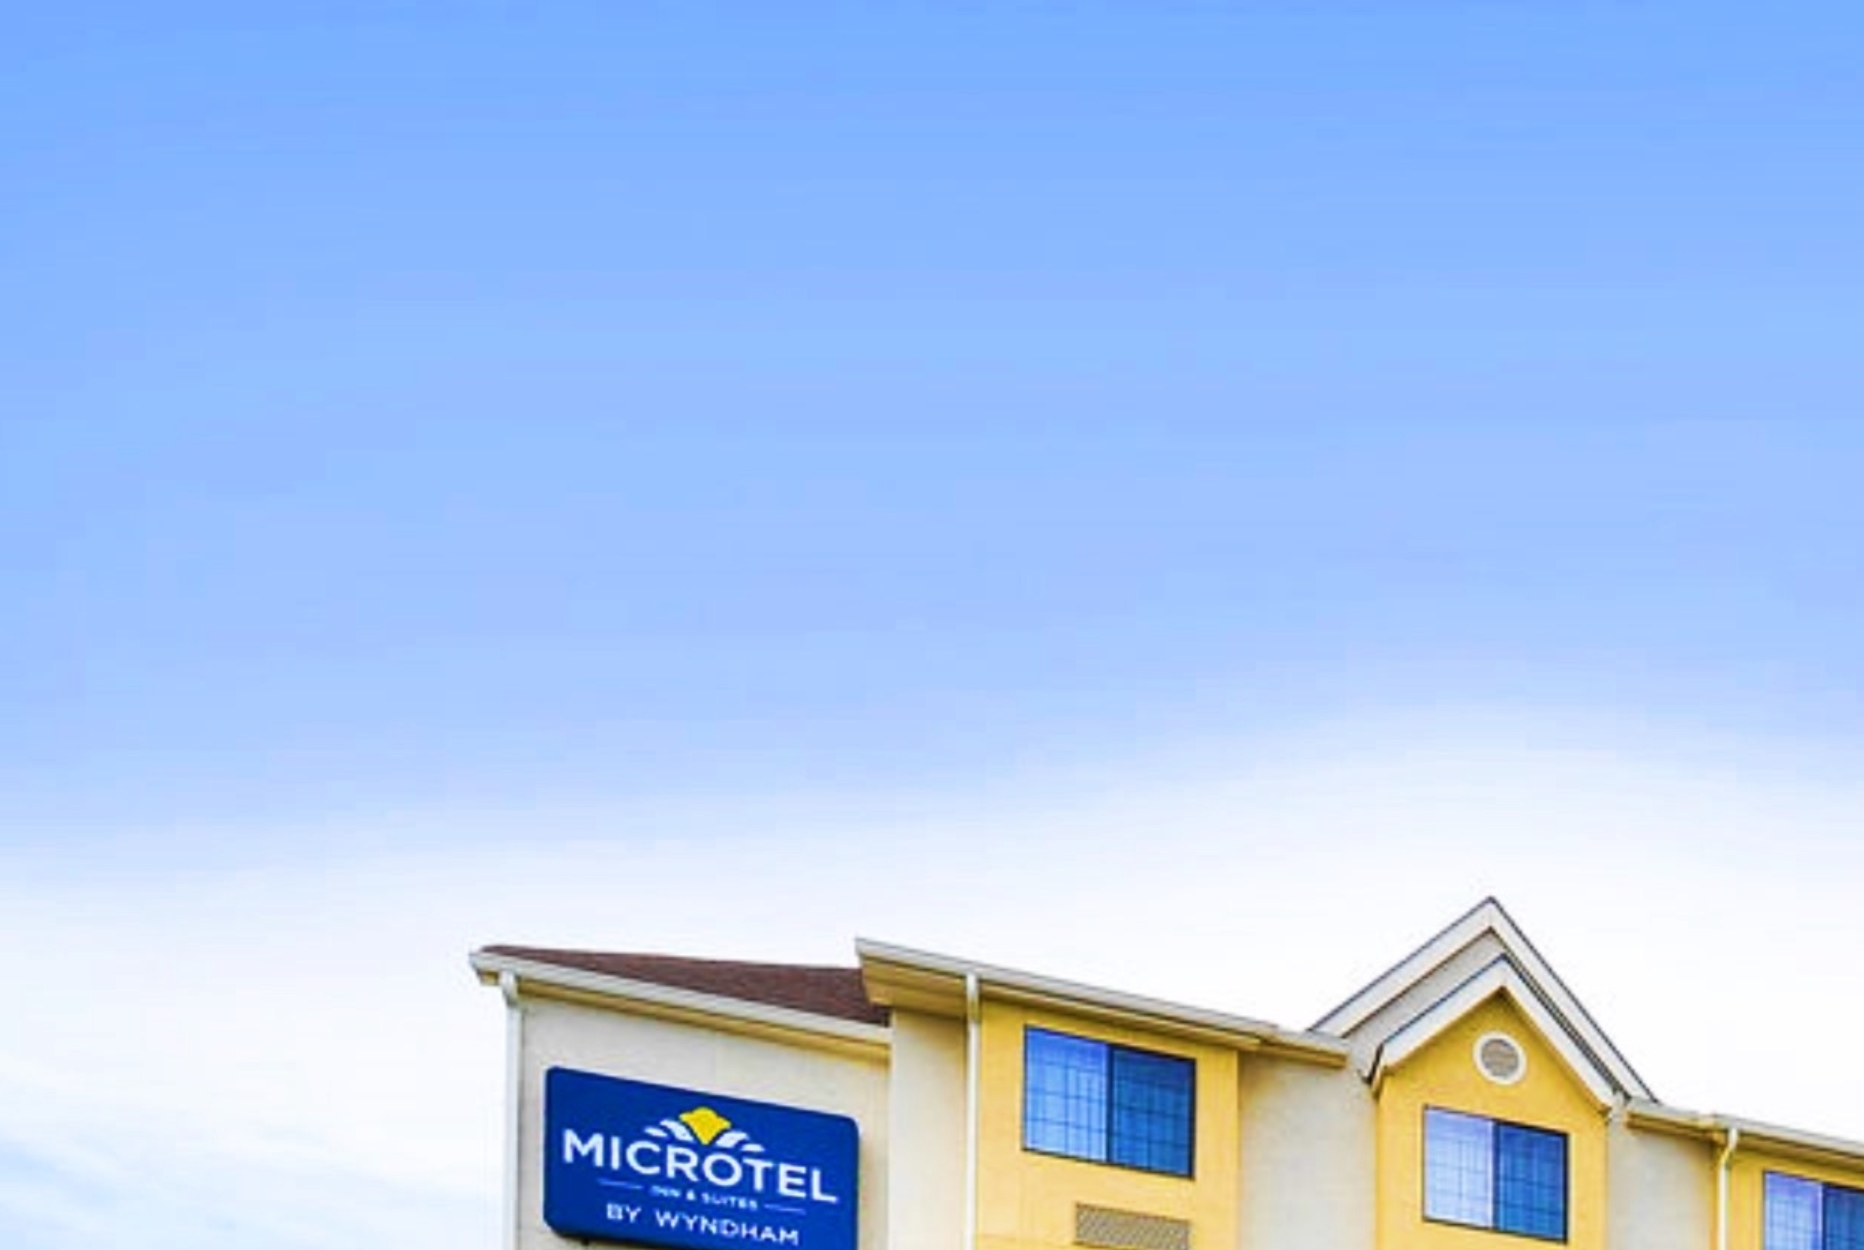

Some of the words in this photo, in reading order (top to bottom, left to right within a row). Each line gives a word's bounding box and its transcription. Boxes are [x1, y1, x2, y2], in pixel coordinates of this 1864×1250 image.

[563, 1129, 838, 1203] MICROTEL
[702, 1192, 758, 1210] SUITES
[607, 1203, 641, 1223] BY
[655, 1210, 799, 1246] WYNDHAM
